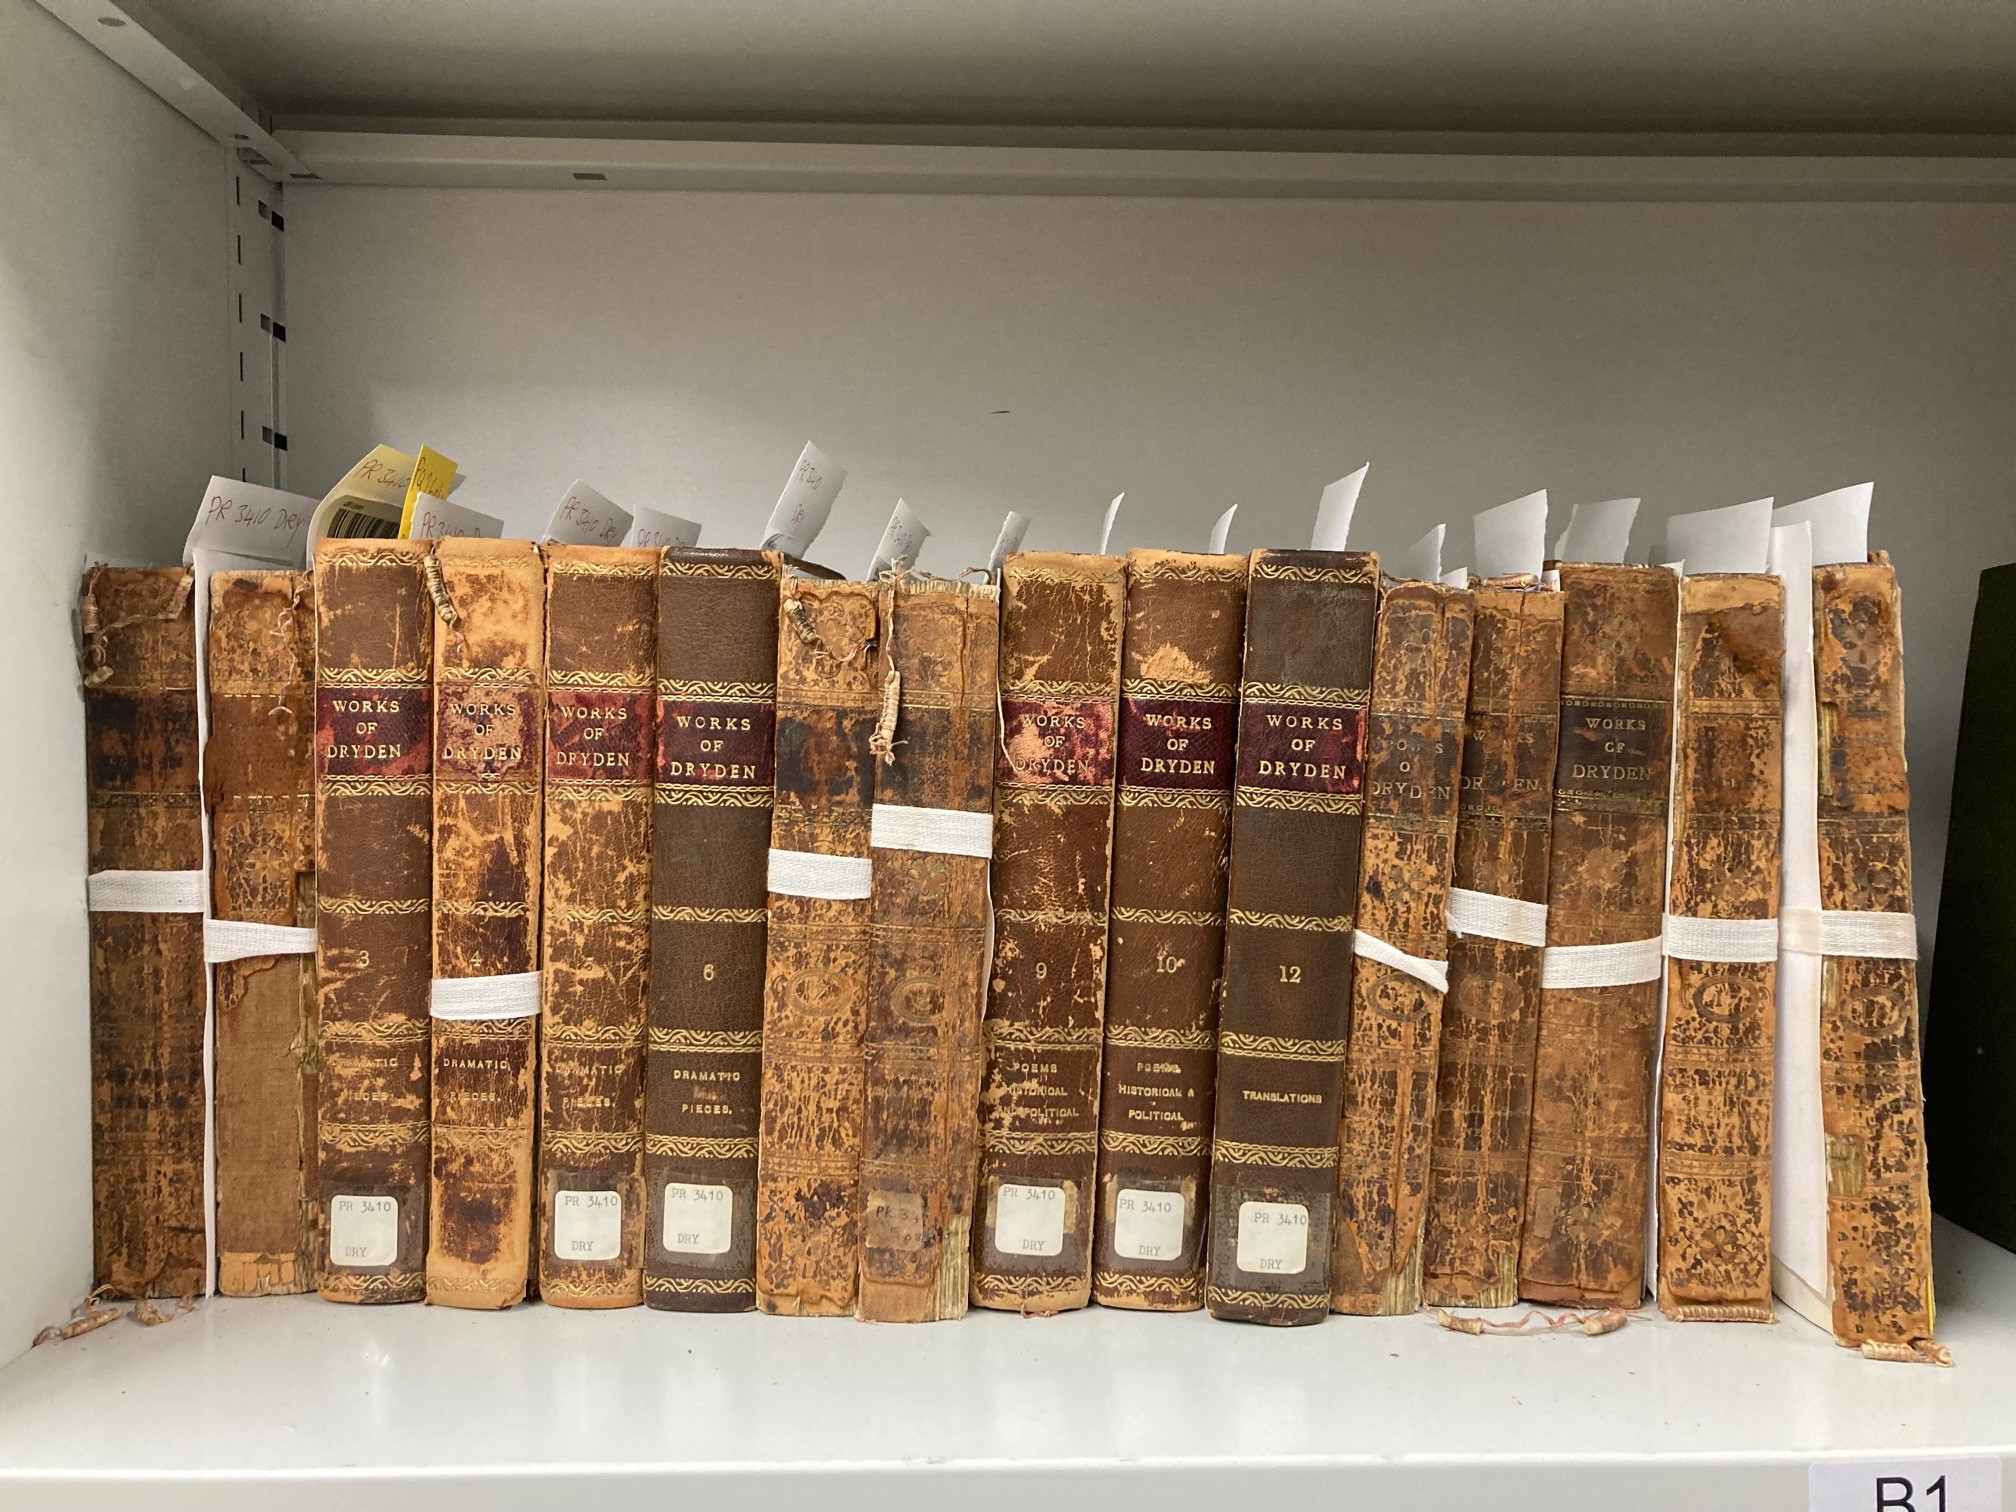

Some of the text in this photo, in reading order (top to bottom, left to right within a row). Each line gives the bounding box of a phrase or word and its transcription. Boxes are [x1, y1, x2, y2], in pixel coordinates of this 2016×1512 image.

[353, 459, 383, 480] PR
[378, 468, 411, 488] 3410
[205, 495, 233, 526] PR
[235, 504, 272, 527] 3410
[560, 496, 580, 521] PR
[421, 511, 437, 538] PR
[333, 700, 400, 714] WORKS
[450, 702, 516, 716] WORKS
[561, 707, 627, 721] WORKS
[356, 721, 378, 735] OF
[676, 715, 751, 731] WORKS
[1020, 714, 1086, 730] WORKS
[1145, 713, 1212, 730] WORKS
[1265, 715, 1343, 731] WORKS
[1585, 717, 1646, 731] WORKS
[474, 723, 495, 737] OF
[584, 727, 605, 741] OF
[701, 739, 723, 753] OF
[1044, 735, 1066, 748] OF
[1166, 738, 1189, 751] OF
[1291, 738, 1316, 752] OF
[326, 744, 401, 759] DRYDEN
[443, 745, 522, 761] DRYDEN
[556, 751, 630, 767] DRYDEN
[1014, 756, 1089, 775] DRYDEN
[1140, 757, 1215, 775] DRYDEN
[670, 761, 756, 780] DRYDEN
[1258, 761, 1346, 780] DRYDEN
[1572, 764, 1652, 781] DRYDEN
[359, 950, 370, 967] 3
[470, 950, 481, 967] 4
[1156, 956, 1178, 973] 10
[703, 965, 715, 981] 6
[1035, 962, 1048, 979] 9
[1279, 965, 1301, 983] 12
[443, 1058, 508, 1069] DRAMATIC
[1013, 1062, 1058, 1073] POEMS
[673, 1069, 741, 1082] DRAMATIC
[1118, 1084, 1182, 1098] HISTORICAL
[1242, 1090, 1322, 1104] TRANSLATIONS
[681, 1103, 733, 1115] PIECES.
[1128, 1109, 1184, 1121] POLITICAL
[564, 1194, 618, 1207] PR 3410
[671, 1188, 724, 1202] PR 3410
[1002, 1186, 1055, 1201] PR 3410
[338, 1201, 391, 1213] PR 3410
[1119, 1198, 1172, 1213] PR 3410
[1254, 1212, 1308, 1225] PR 3410
[571, 1240, 594, 1252] DRY
[677, 1233, 699, 1245] DRY
[1022, 1239, 1045, 1251] DRY
[345, 1246, 367, 1258] DRY
[1138, 1244, 1160, 1257] DRY
[1260, 1258, 1283, 1271] DRY
[1876, 1475, 1946, 1512] B1
